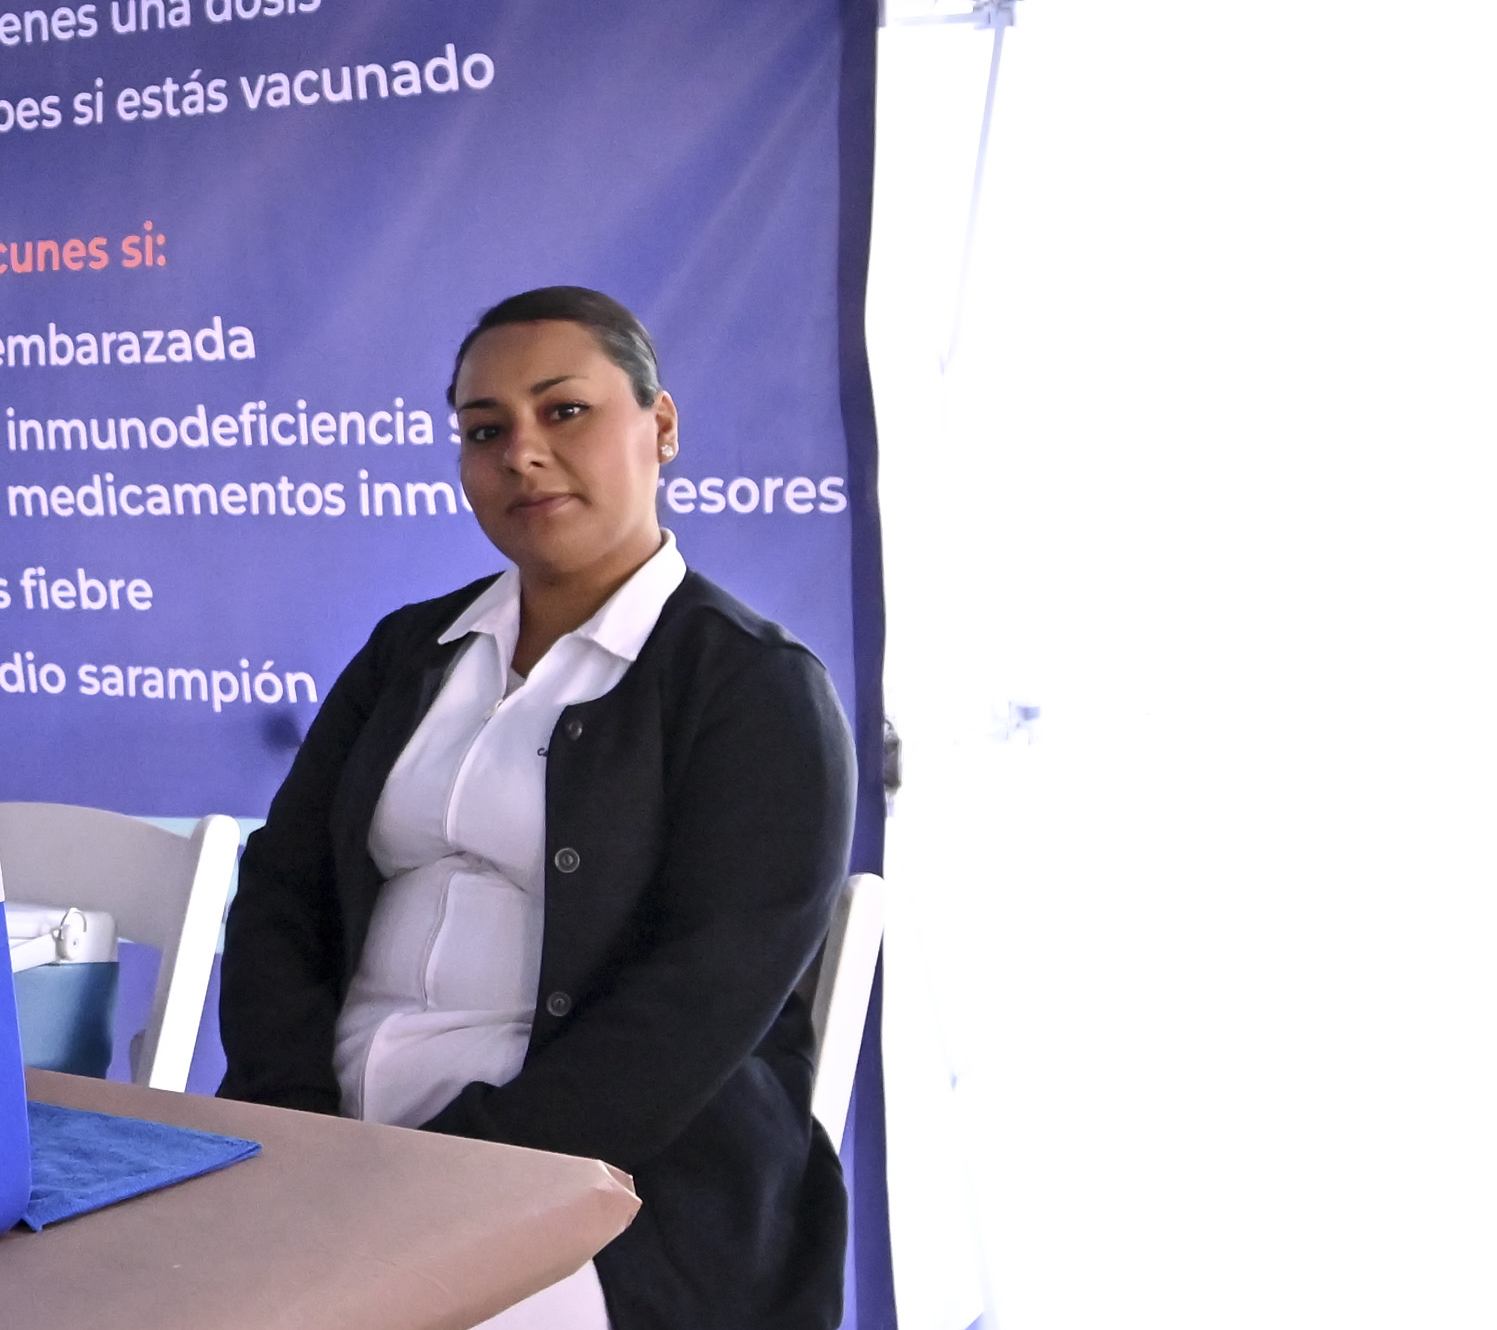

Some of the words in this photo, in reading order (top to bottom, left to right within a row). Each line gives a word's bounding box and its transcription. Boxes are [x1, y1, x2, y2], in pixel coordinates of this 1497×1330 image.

[73, 76, 105, 125] si
[116, 68, 229, 121] estás
[241, 41, 496, 111] vacunado
[122, 221, 167, 269] si:
[5, 396, 434, 455] inmunodeficiencia
[8, 470, 347, 520] medicamentos
[20, 566, 154, 613] fiebre
[77, 658, 318, 713] sarampión
